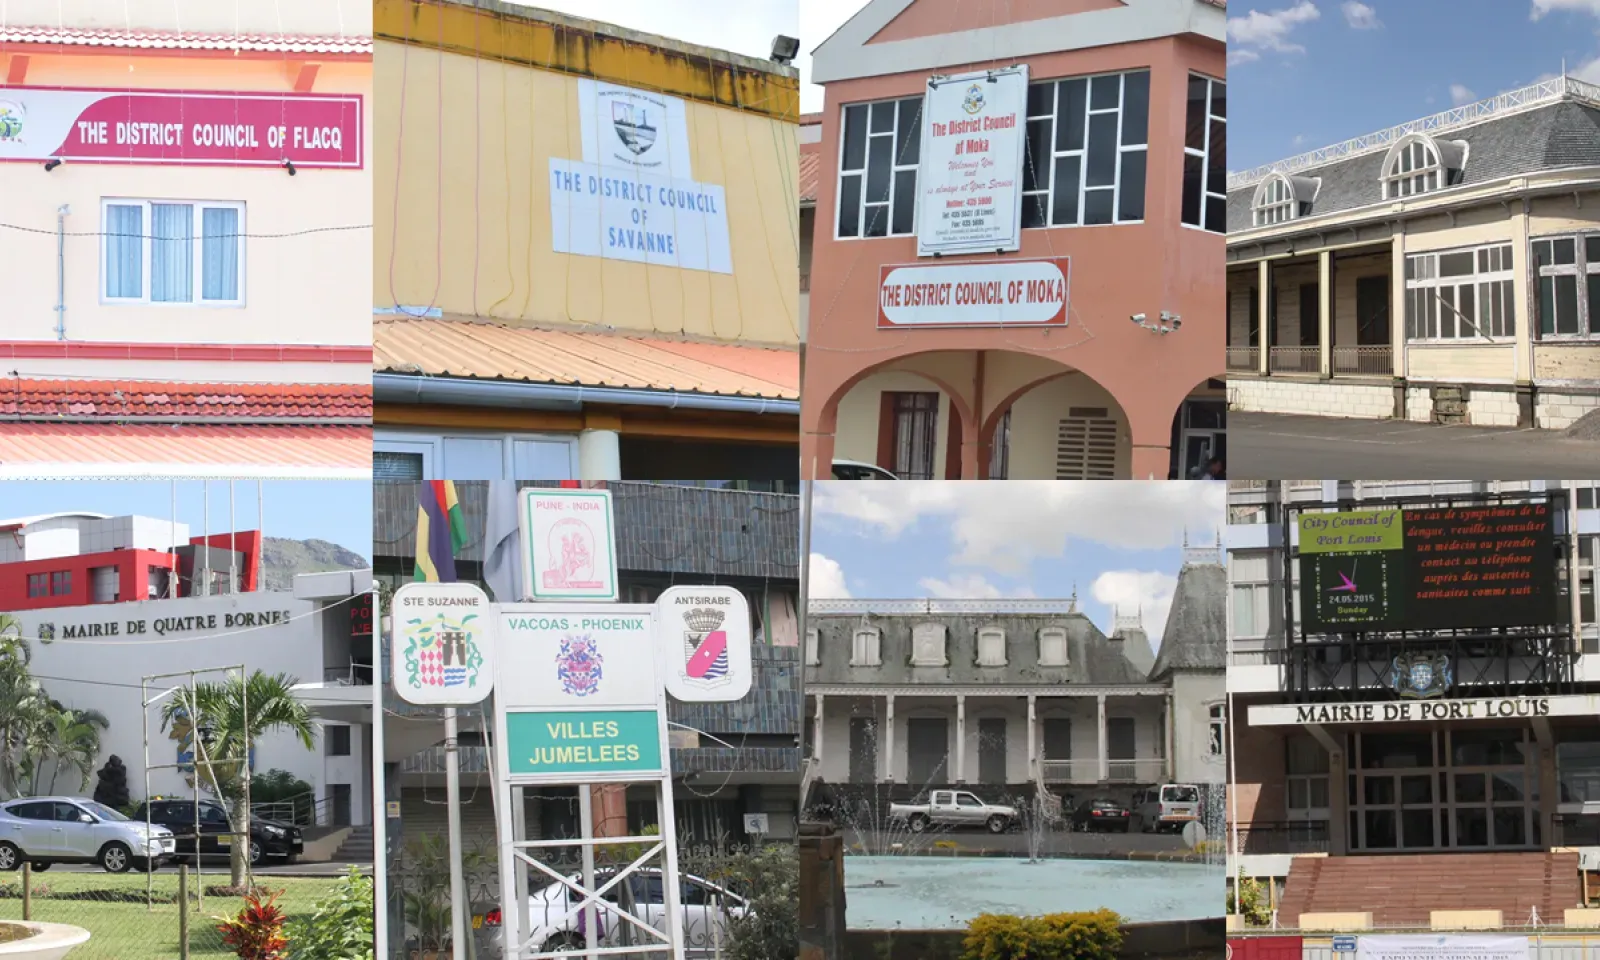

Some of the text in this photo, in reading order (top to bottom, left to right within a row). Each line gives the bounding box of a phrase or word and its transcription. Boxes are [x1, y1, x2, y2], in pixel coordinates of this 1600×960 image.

[932, 113, 1016, 137] The District Council
[78, 122, 342, 150] THE DISTRICT COUNCIL OF FLACQ
[955, 139, 990, 156] of Moka
[554, 170, 718, 214] THE DISTRICT COUNCIL
[632, 208, 648, 226] OF
[609, 226, 674, 254] SAVANNE
[883, 278, 1063, 307] THE DISTRICT COUNCIL OF MOKA
[536, 500, 564, 511] PUNE
[572, 501, 600, 512] INDIA
[1404, 511, 1420, 521] En
[1424, 512, 1441, 520] cas
[1444, 509, 1456, 519] de
[1520, 506, 1532, 516] de
[1535, 505, 1546, 514] la
[1303, 512, 1397, 531] City Council of
[1496, 522, 1546, 533] consulter
[1317, 532, 1382, 545] Port Louis
[1417, 544, 1432, 552] un
[1480, 541, 1493, 549] ou
[1496, 538, 1536, 552] prendre
[1421, 556, 1461, 568] contact
[1464, 558, 1478, 566] au
[1462, 571, 1479, 582] des
[1328, 594, 1375, 604] 24.05.2015
[1416, 587, 1469, 599] sanitaires
[1472, 587, 1507, 597] comme
[1510, 585, 1532, 595] suit
[403, 597, 479, 608] STE SUZANNE
[674, 596, 731, 605] ANTSIRABE
[1337, 606, 1368, 614] Sunday
[62, 610, 290, 639] MAIRIE DE QUATRE BORNES
[508, 618, 570, 630] VACOAS
[582, 618, 644, 630] PHOENIX
[1296, 698, 1550, 723] MAIRIE DE PORT LOUIS
[547, 721, 619, 738] VILLES
[529, 744, 640, 766] JUMELEES
